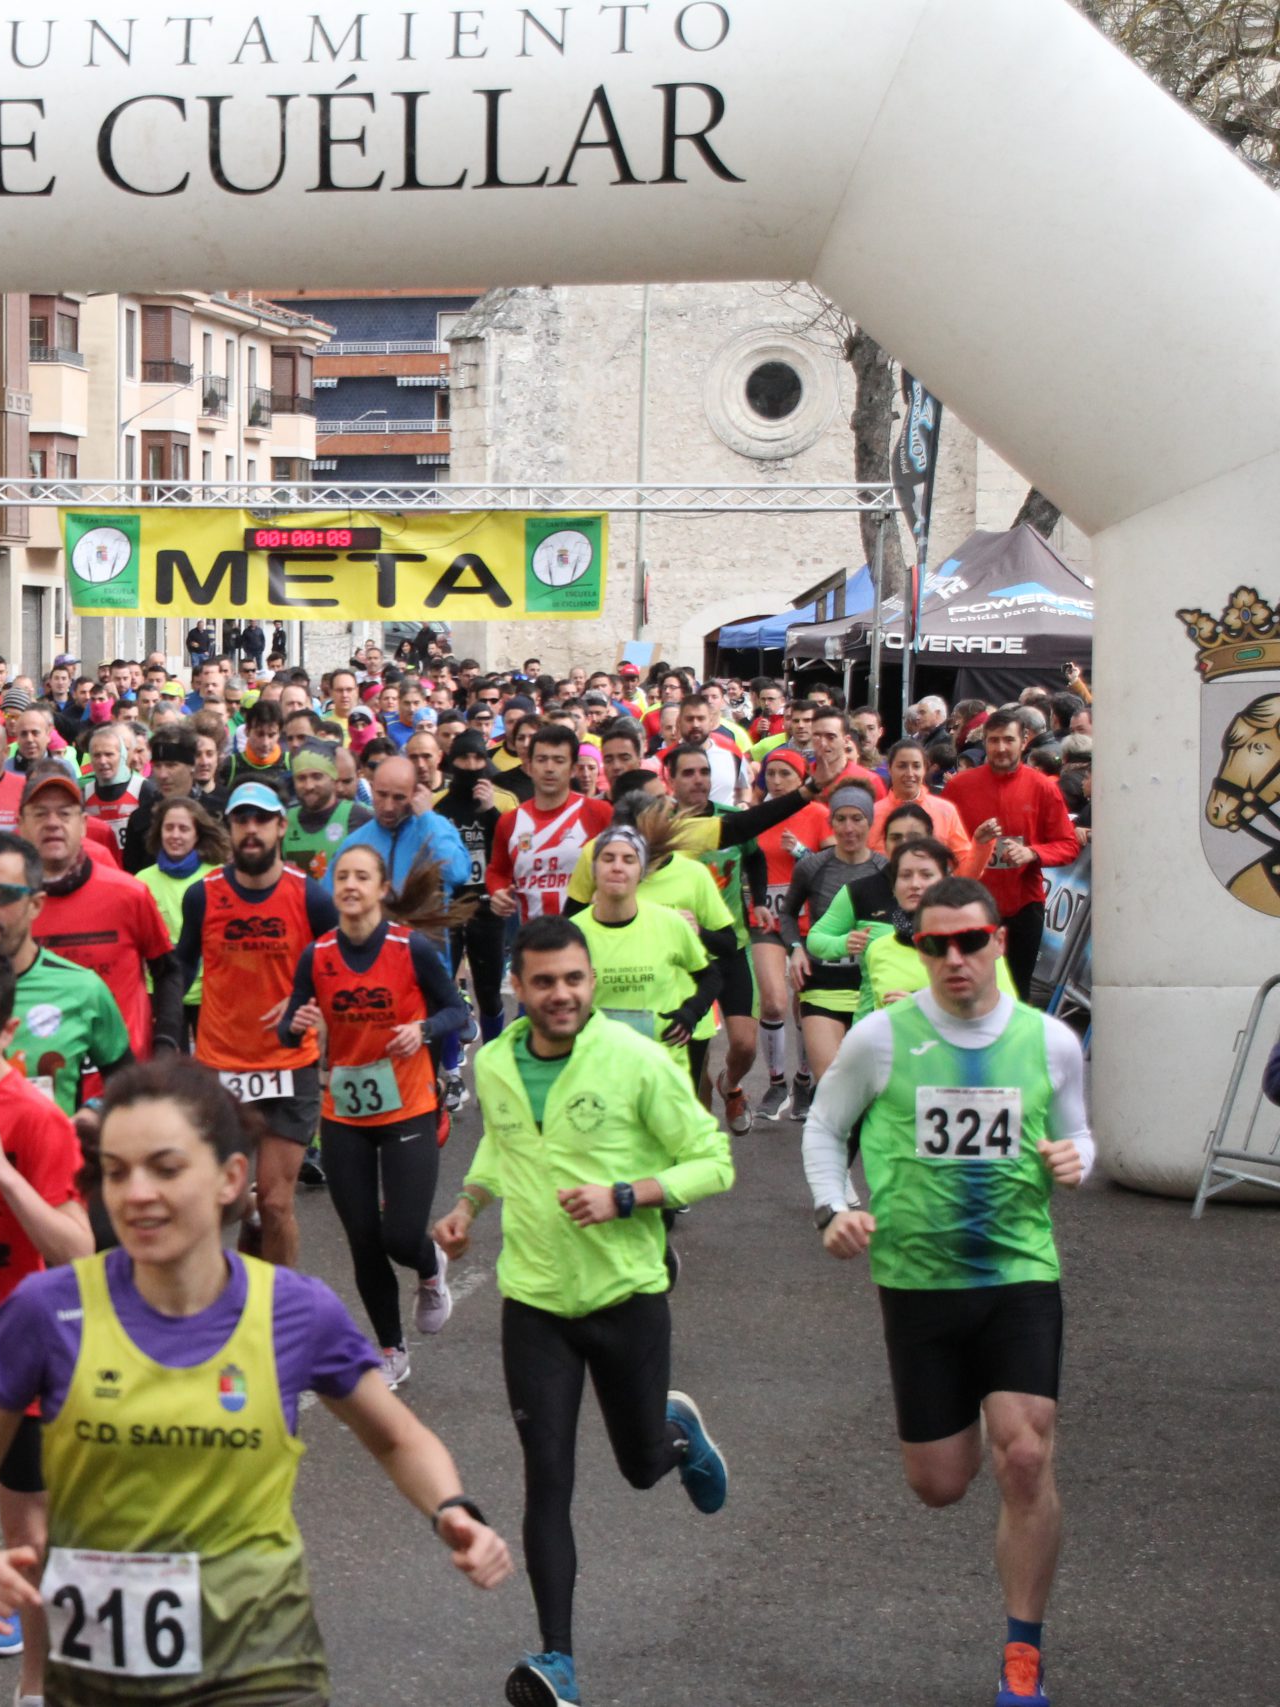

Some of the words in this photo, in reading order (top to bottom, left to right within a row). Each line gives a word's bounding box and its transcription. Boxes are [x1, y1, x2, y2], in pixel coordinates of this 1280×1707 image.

[96, 73, 748, 197] CUÉLLAR
[255, 530, 351, 547] 00:00:09
[155, 550, 512, 609] META
[228, 1070, 283, 1099] 301
[344, 1079, 383, 1114] 33
[924, 1107, 1011, 1156] 324
[75, 1420, 120, 1444] C.D.
[53, 1585, 185, 1668] 216
